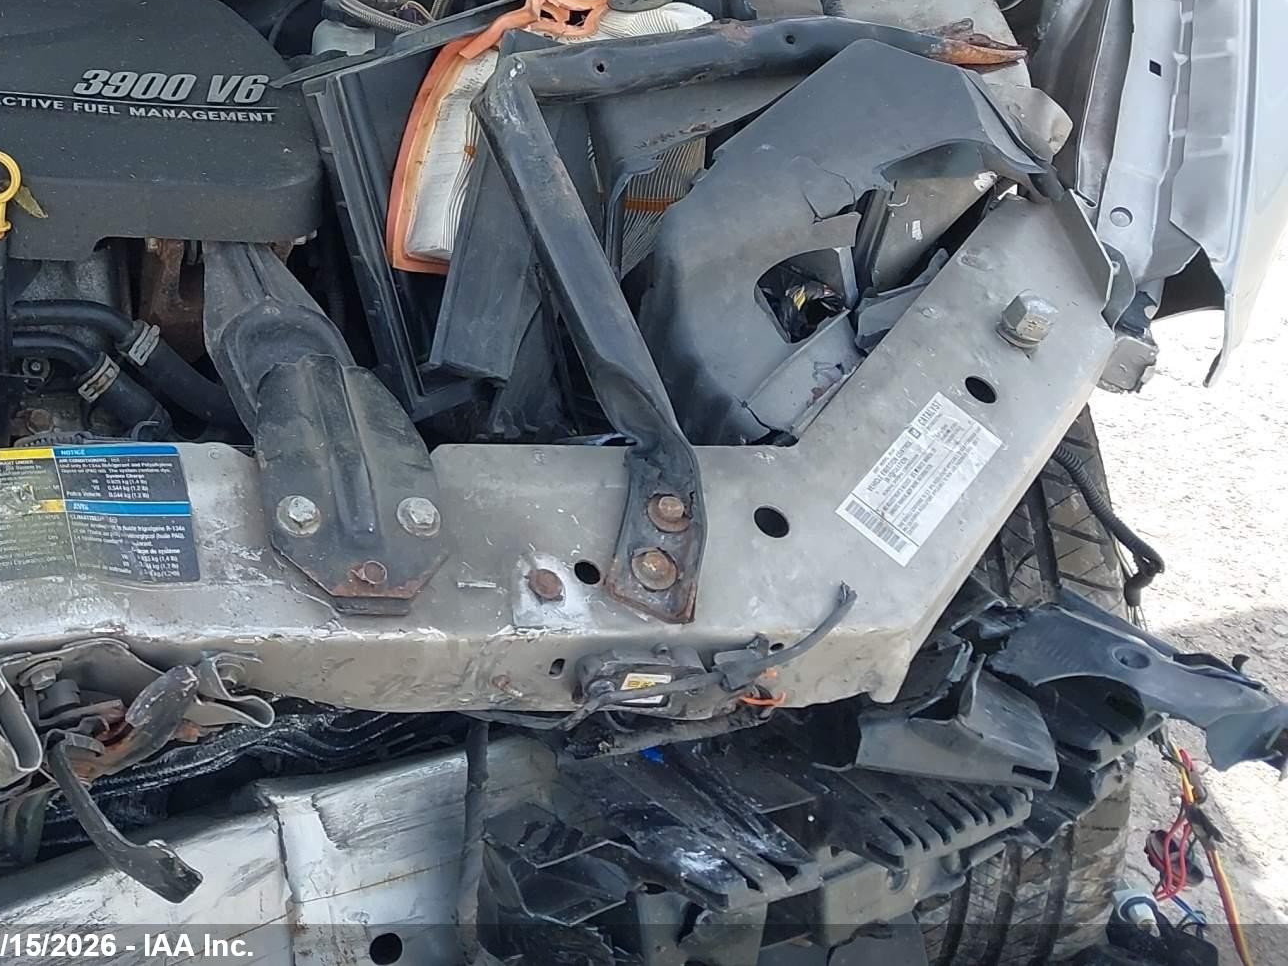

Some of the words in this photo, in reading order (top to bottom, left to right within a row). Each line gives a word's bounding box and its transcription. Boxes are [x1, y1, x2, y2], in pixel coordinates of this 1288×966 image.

[73, 69, 197, 101] 3900
[205, 73, 270, 104] V6
[72, 102, 120, 115] FUEL
[128, 105, 277, 123] MANAGEMENT
[917, 400, 943, 426] CATALYST
